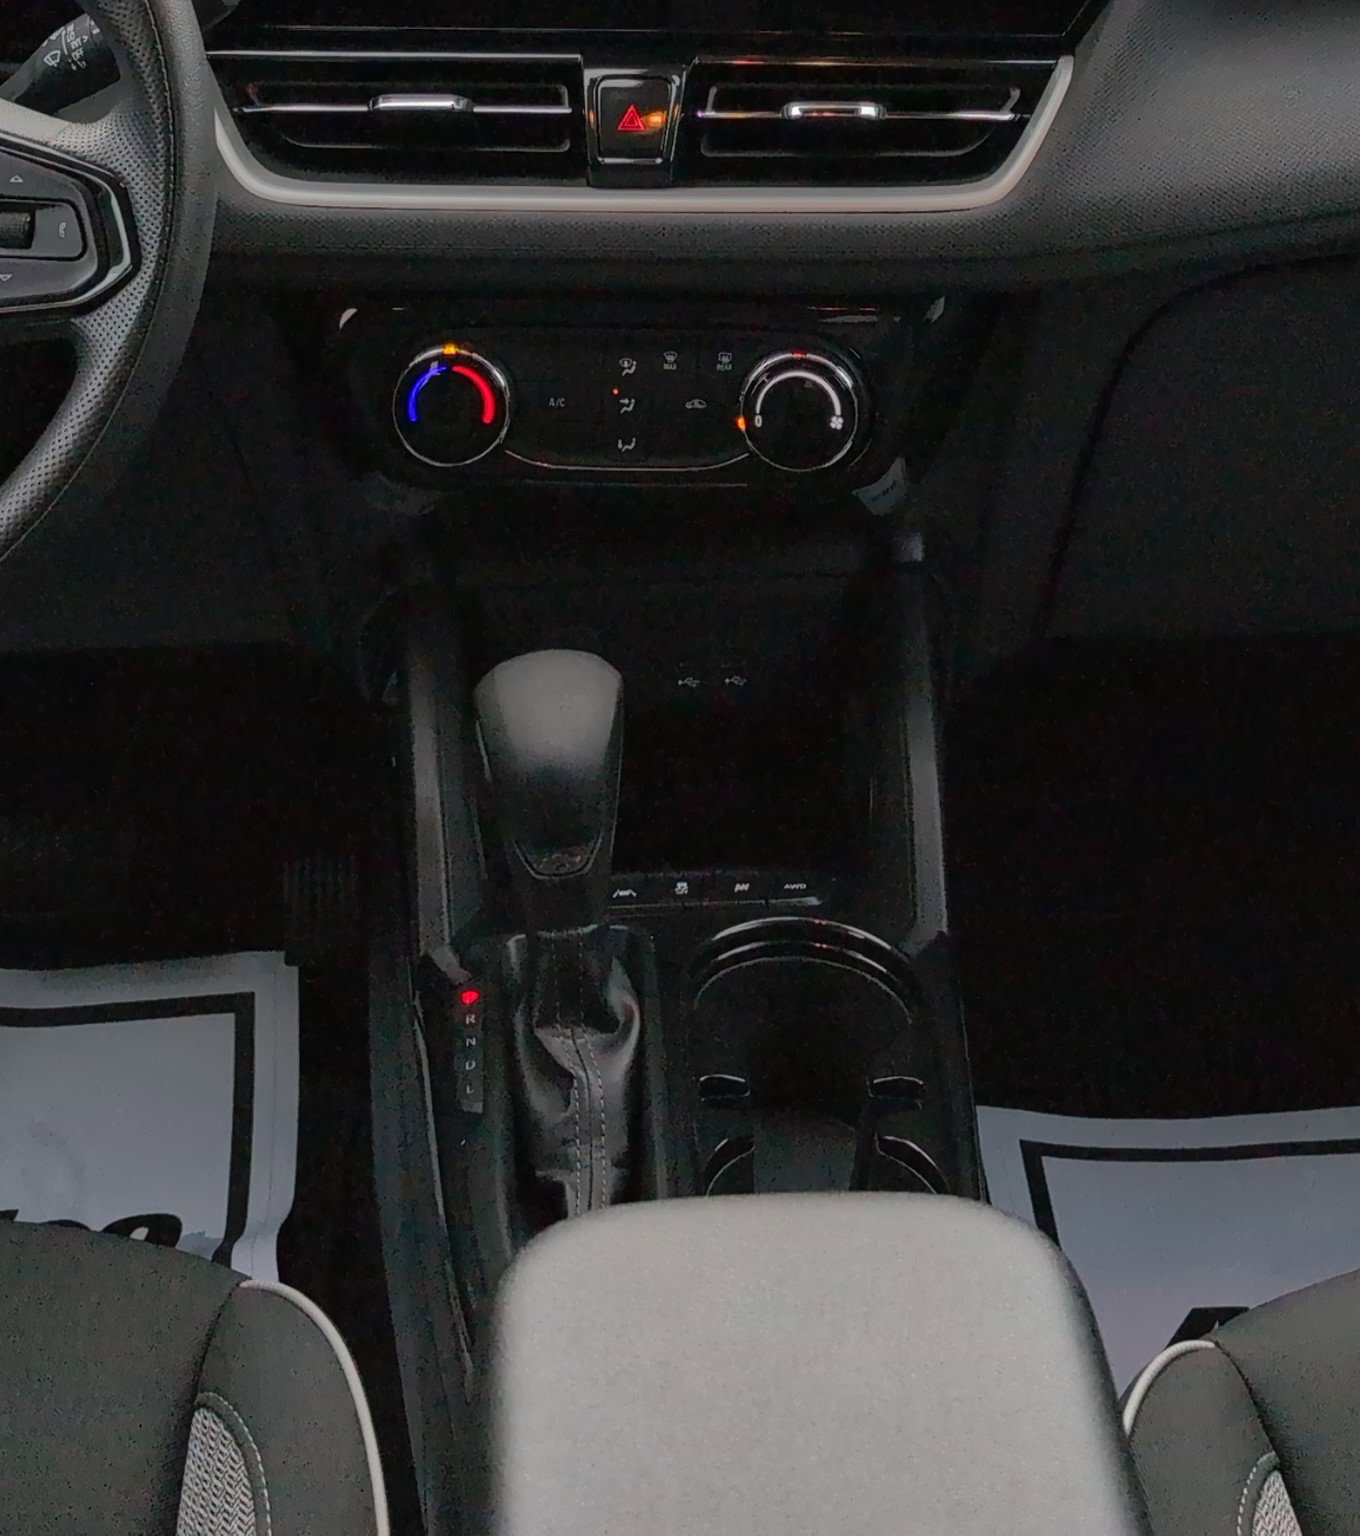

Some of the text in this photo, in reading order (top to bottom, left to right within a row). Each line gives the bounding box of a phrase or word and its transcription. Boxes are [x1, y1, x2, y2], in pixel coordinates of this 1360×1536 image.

[548, 398, 566, 407] A/C
[754, 415, 762, 427] 0
[466, 1014, 476, 1024] R
[466, 1037, 476, 1046] N
[466, 1060, 476, 1070] D
